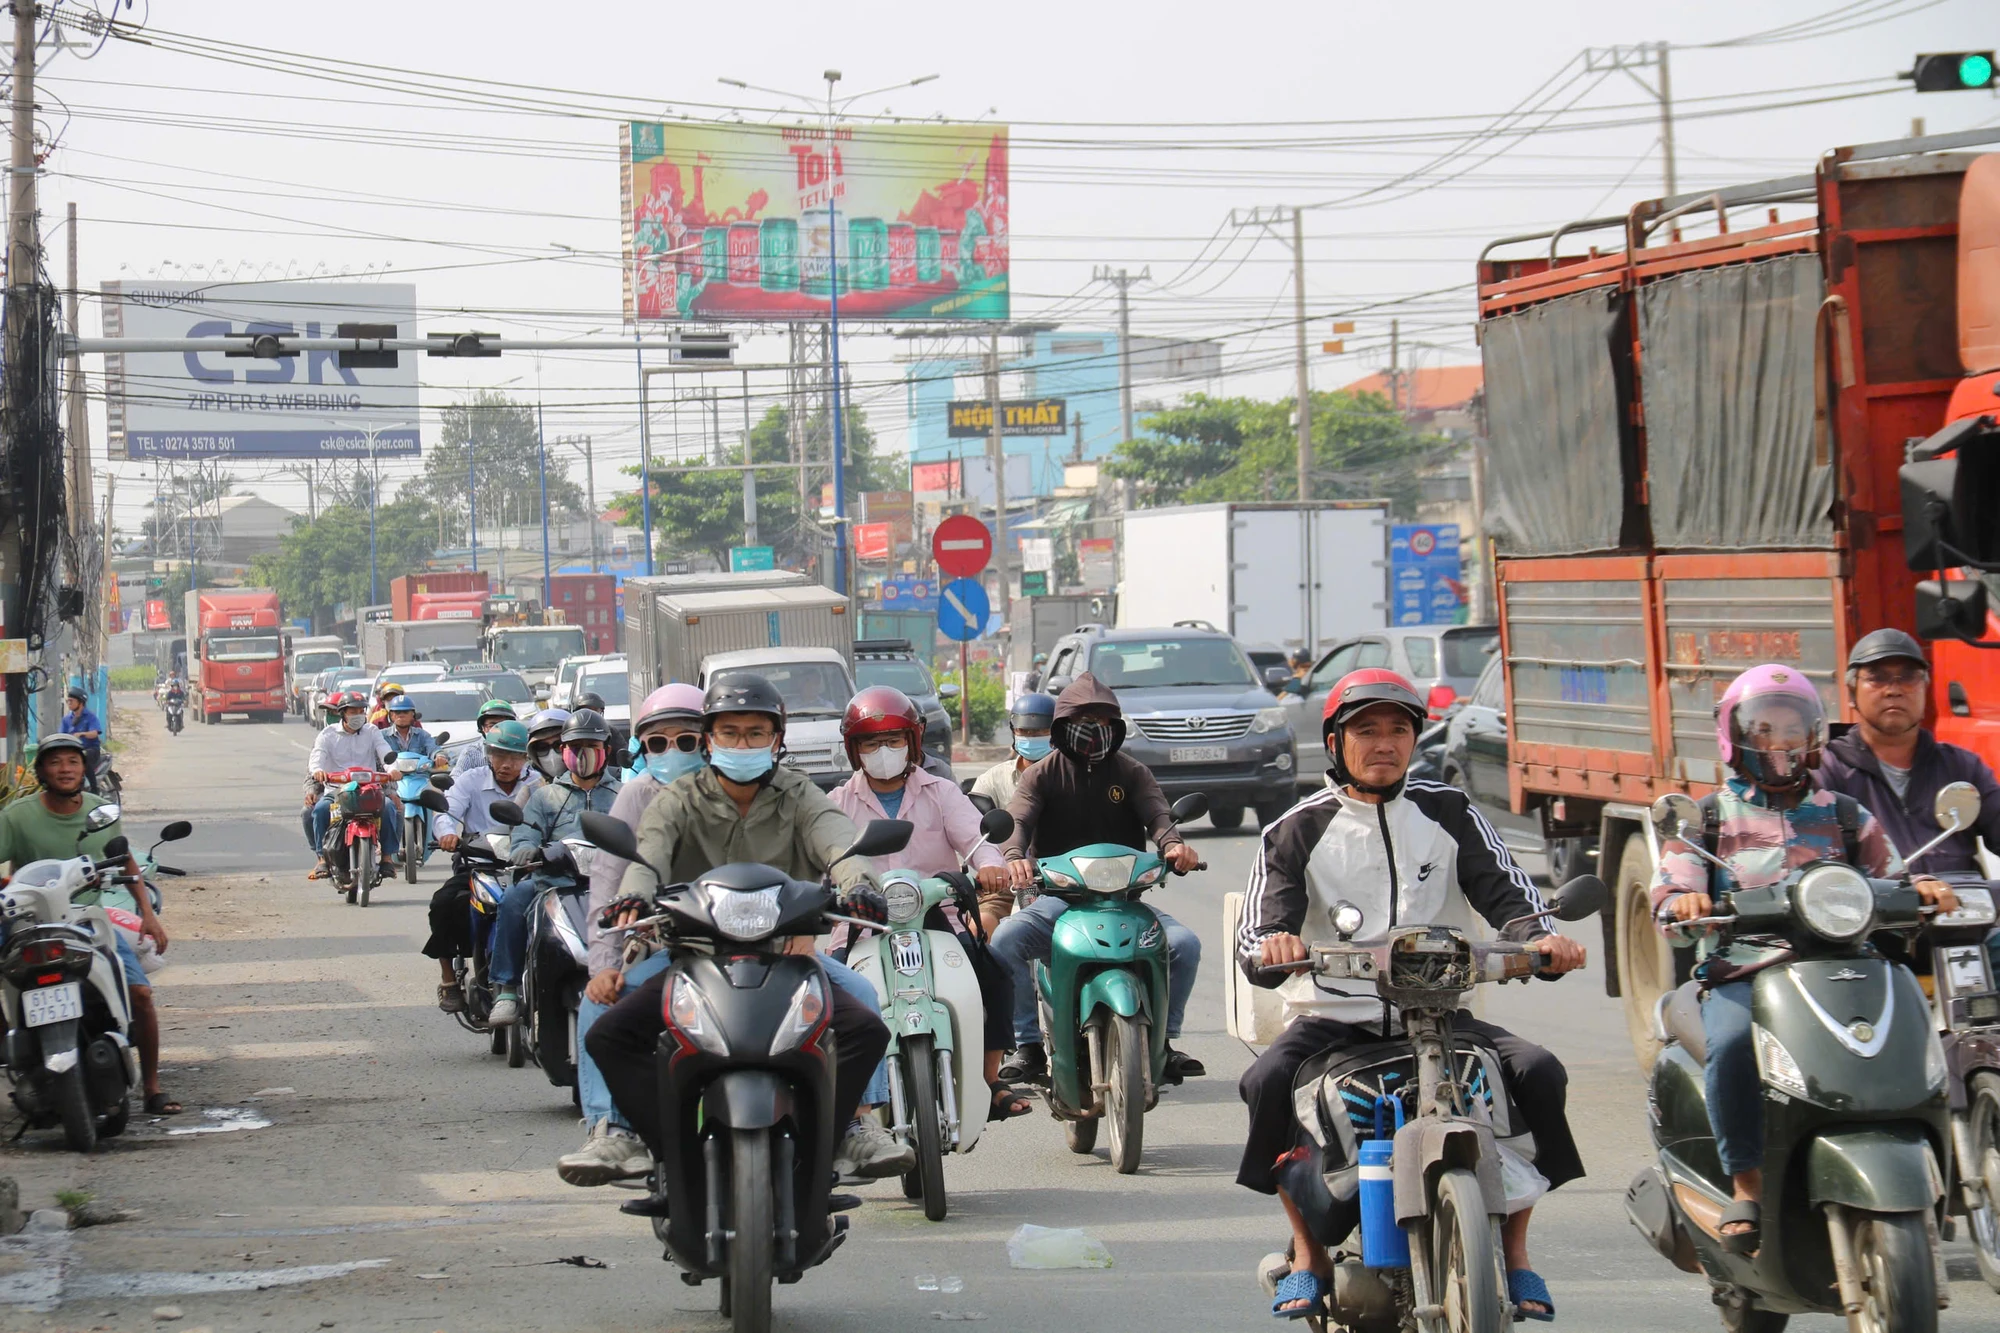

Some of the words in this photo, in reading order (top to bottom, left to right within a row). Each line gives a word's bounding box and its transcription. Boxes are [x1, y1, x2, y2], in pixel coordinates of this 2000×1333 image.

[131, 290, 205, 305] CHUNSHIN
[183, 321, 362, 387] CSK
[188, 392, 253, 412] ZIPPER
[258, 393, 271, 411] &
[276, 393, 362, 412] WEBBING
[952, 403, 994, 432] NỘI
[1003, 399, 1062, 425] THẤT
[137, 436, 158, 451] TEL
[191, 436, 216, 451] 3578
[218, 436, 236, 450] 501
[231, 618, 253, 627] FAW
[464, 664, 489, 672] VINASUN
[1172, 747, 1226, 762] 51F-506.47
[31, 986, 70, 1007] 61-C1
